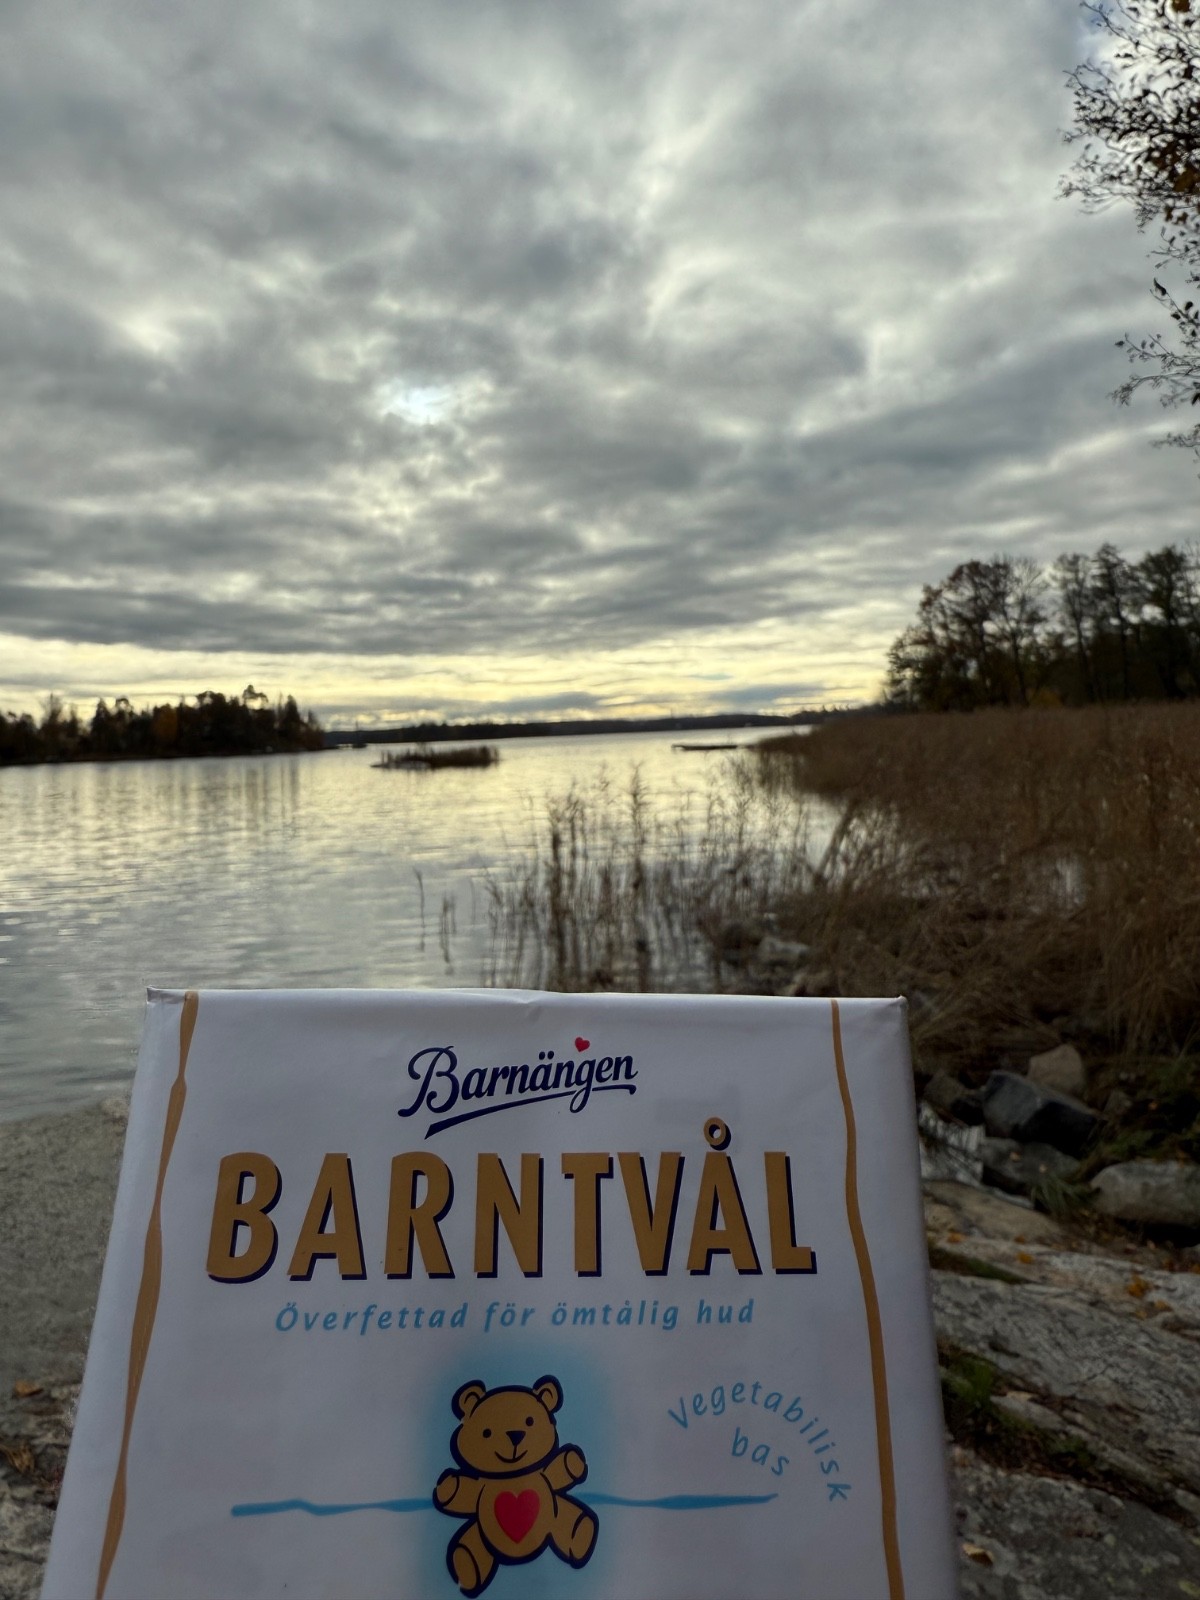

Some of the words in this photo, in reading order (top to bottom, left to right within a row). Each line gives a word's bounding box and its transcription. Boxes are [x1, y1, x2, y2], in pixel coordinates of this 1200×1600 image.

[397, 1045, 638, 1117] Barnängen
[206, 1117, 817, 1284] BARNTVÅL
[275, 1301, 469, 1336] Överfettad
[484, 1300, 536, 1332] för
[551, 1299, 679, 1331] ömtålig
[696, 1299, 755, 1326] hud
[667, 1380, 852, 1501] Vegetabilisk
[731, 1426, 790, 1476] bas
